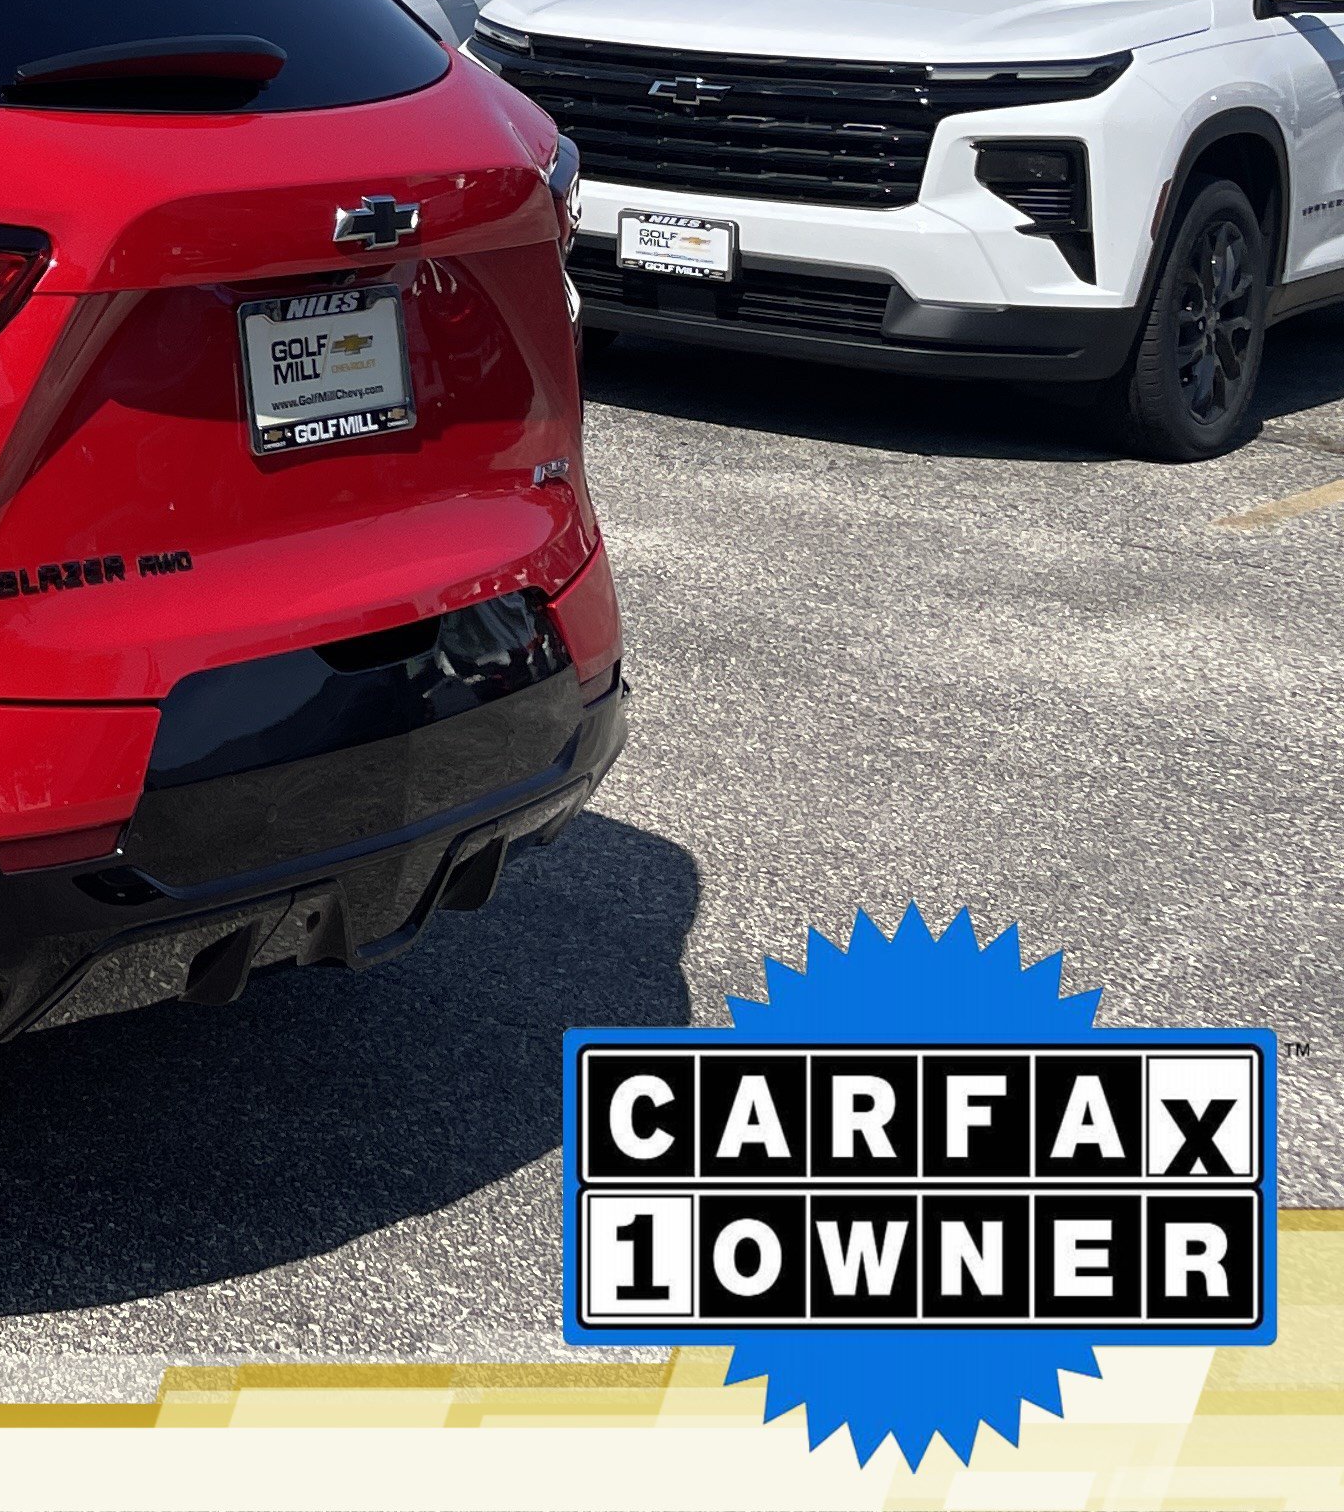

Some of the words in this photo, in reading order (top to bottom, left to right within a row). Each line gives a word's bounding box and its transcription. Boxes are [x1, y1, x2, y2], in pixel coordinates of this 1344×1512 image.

[639, 228, 679, 241] GOLF
[648, 214, 702, 228] NILES
[639, 237, 671, 249] MILL
[644, 261, 675, 274] GOLF
[675, 266, 704, 277] MILL
[286, 291, 361, 320] NILES
[271, 334, 328, 363] GOLF
[273, 358, 322, 386] MILL
[294, 418, 339, 444] GOLF
[338, 412, 379, 437] MILL
[135, 549, 195, 578] AWD
